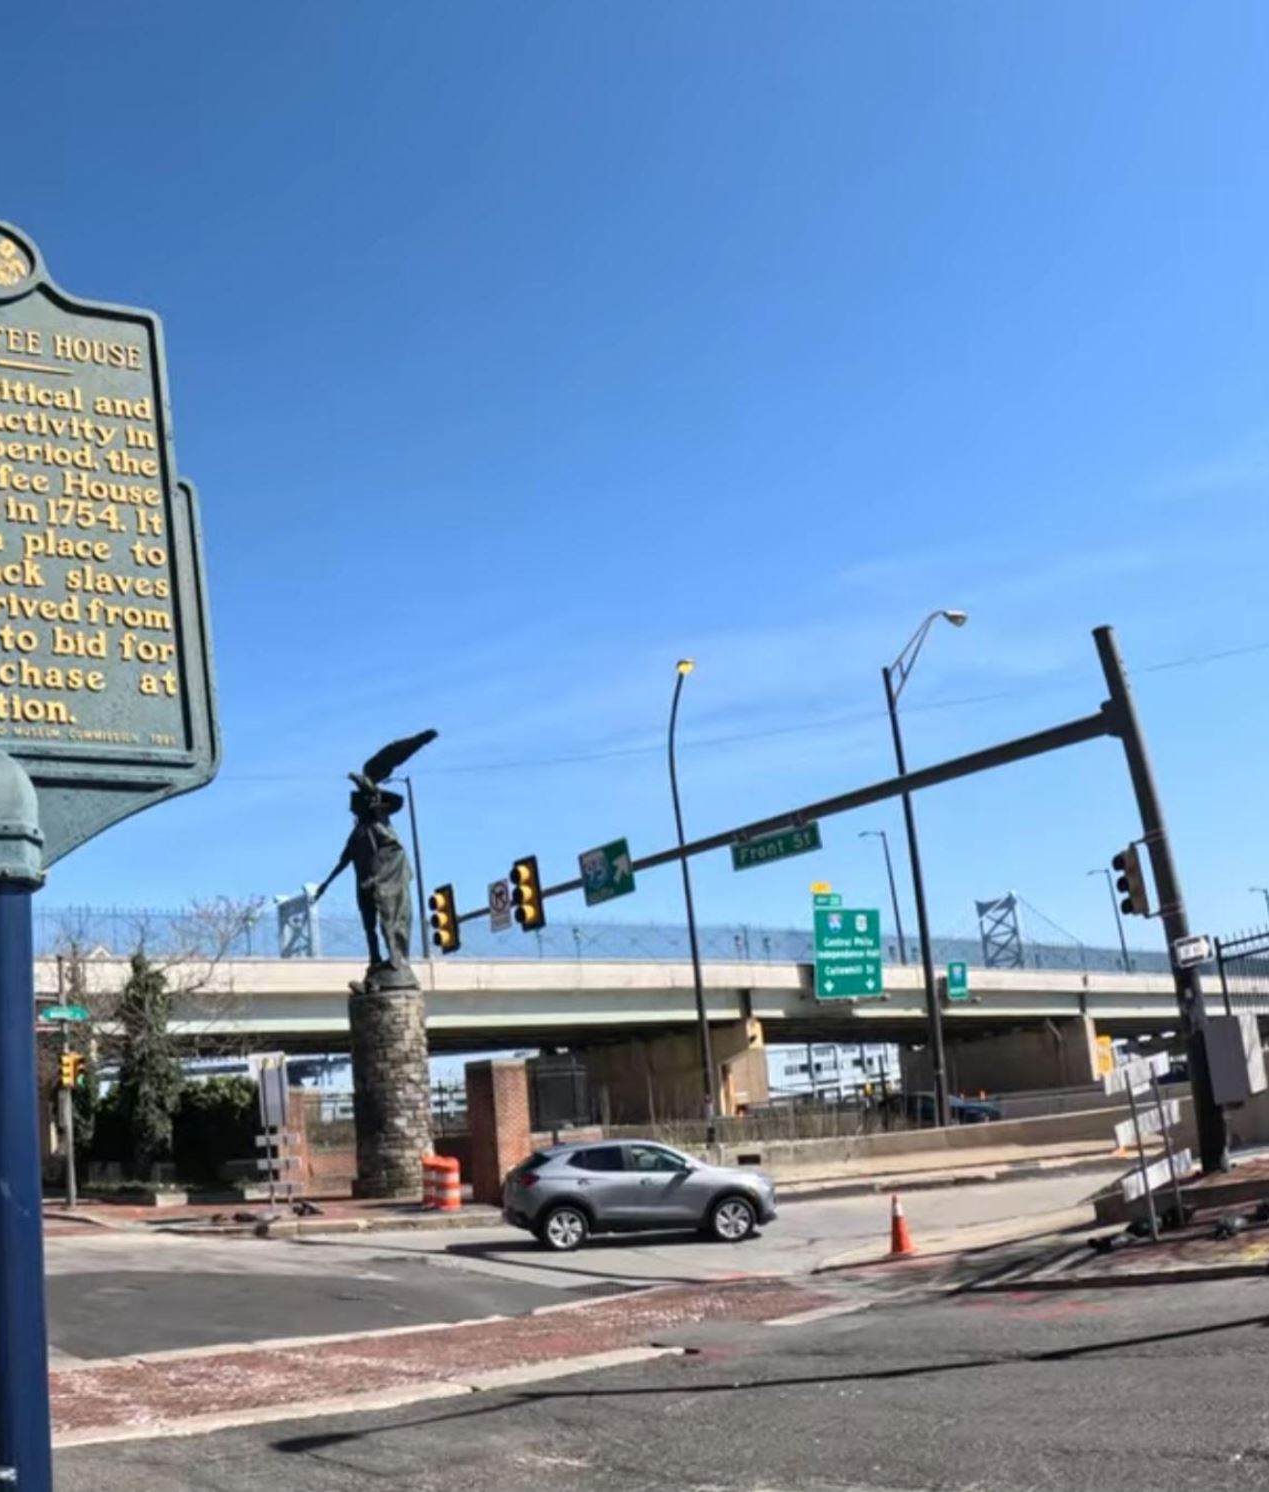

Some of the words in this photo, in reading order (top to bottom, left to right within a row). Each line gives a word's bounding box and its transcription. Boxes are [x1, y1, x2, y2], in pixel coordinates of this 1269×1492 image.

[53, 335, 142, 370] HOUSE
[94, 397, 151, 421] and
[126, 428, 154, 450] in
[106, 449, 158, 477] the
[64, 472, 160, 507] House
[7, 496, 38, 524] in
[136, 509, 163, 536] It
[23, 530, 111, 561] place
[132, 542, 168, 567] to
[66, 566, 170, 599] slaves
[88, 598, 172, 631] from
[0, 628, 38, 653] to
[52, 627, 107, 660] bid
[119, 634, 174, 663] for
[139, 670, 178, 696] at
[14, 726, 61, 739] MUSEUM
[739, 840, 784, 864] Front
[793, 832, 812, 850] St
